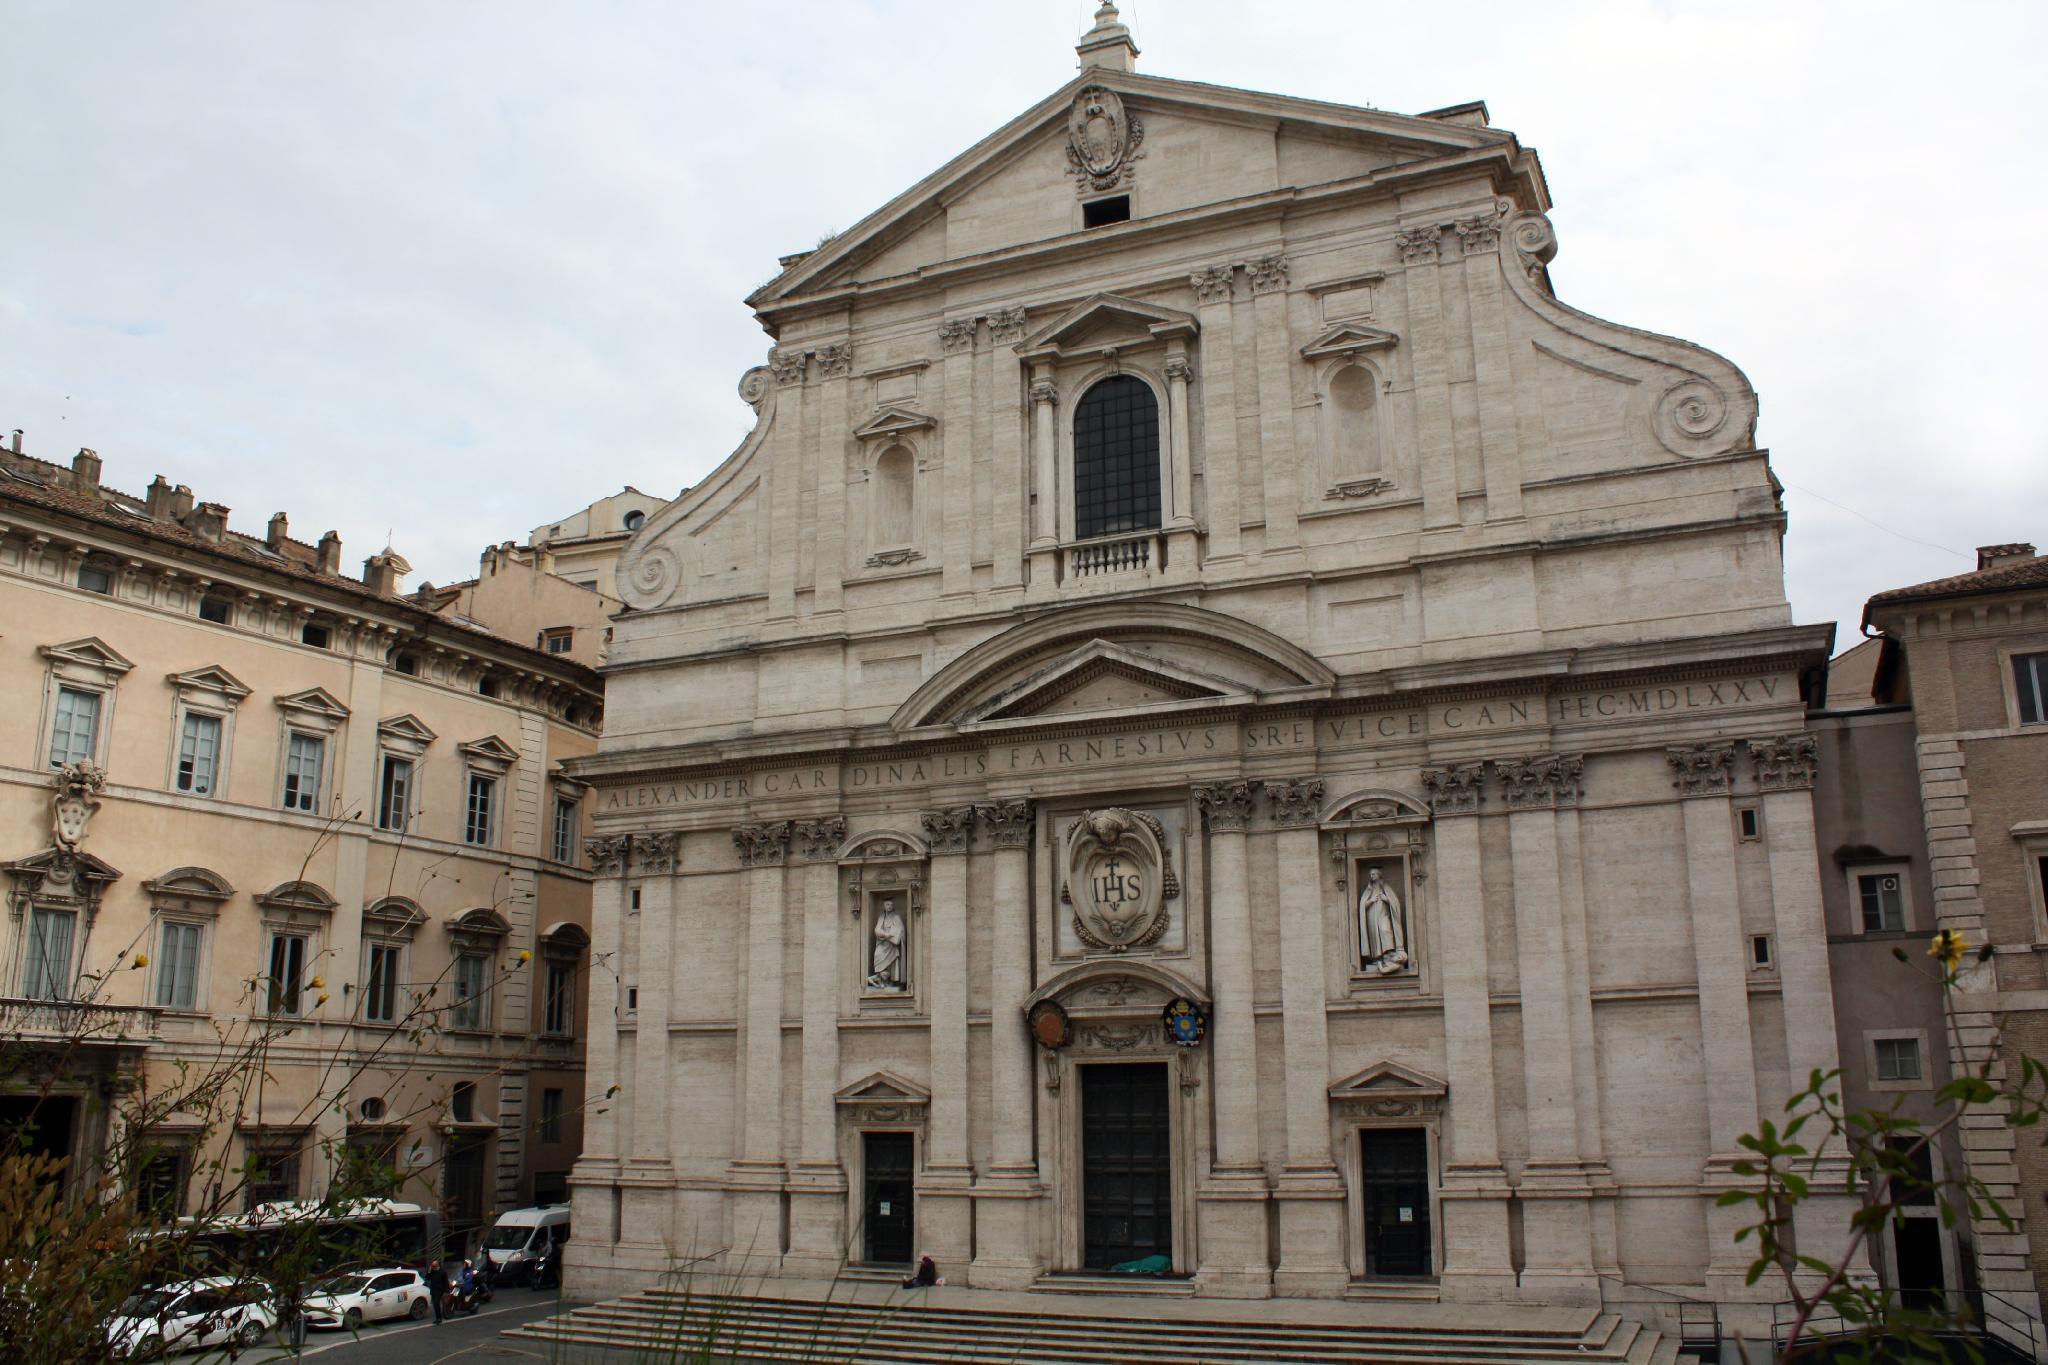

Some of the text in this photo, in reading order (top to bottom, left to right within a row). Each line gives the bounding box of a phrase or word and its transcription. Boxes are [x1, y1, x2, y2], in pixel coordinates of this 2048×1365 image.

[608, 779, 750, 808] ALEXANDER
[765, 754, 986, 792] CARDINALIS
[1011, 729, 1215, 768] FARNESIVS
[1329, 713, 1419, 740] VICE
[1444, 701, 1528, 728] CAN
[1093, 874, 1142, 903] IHS
